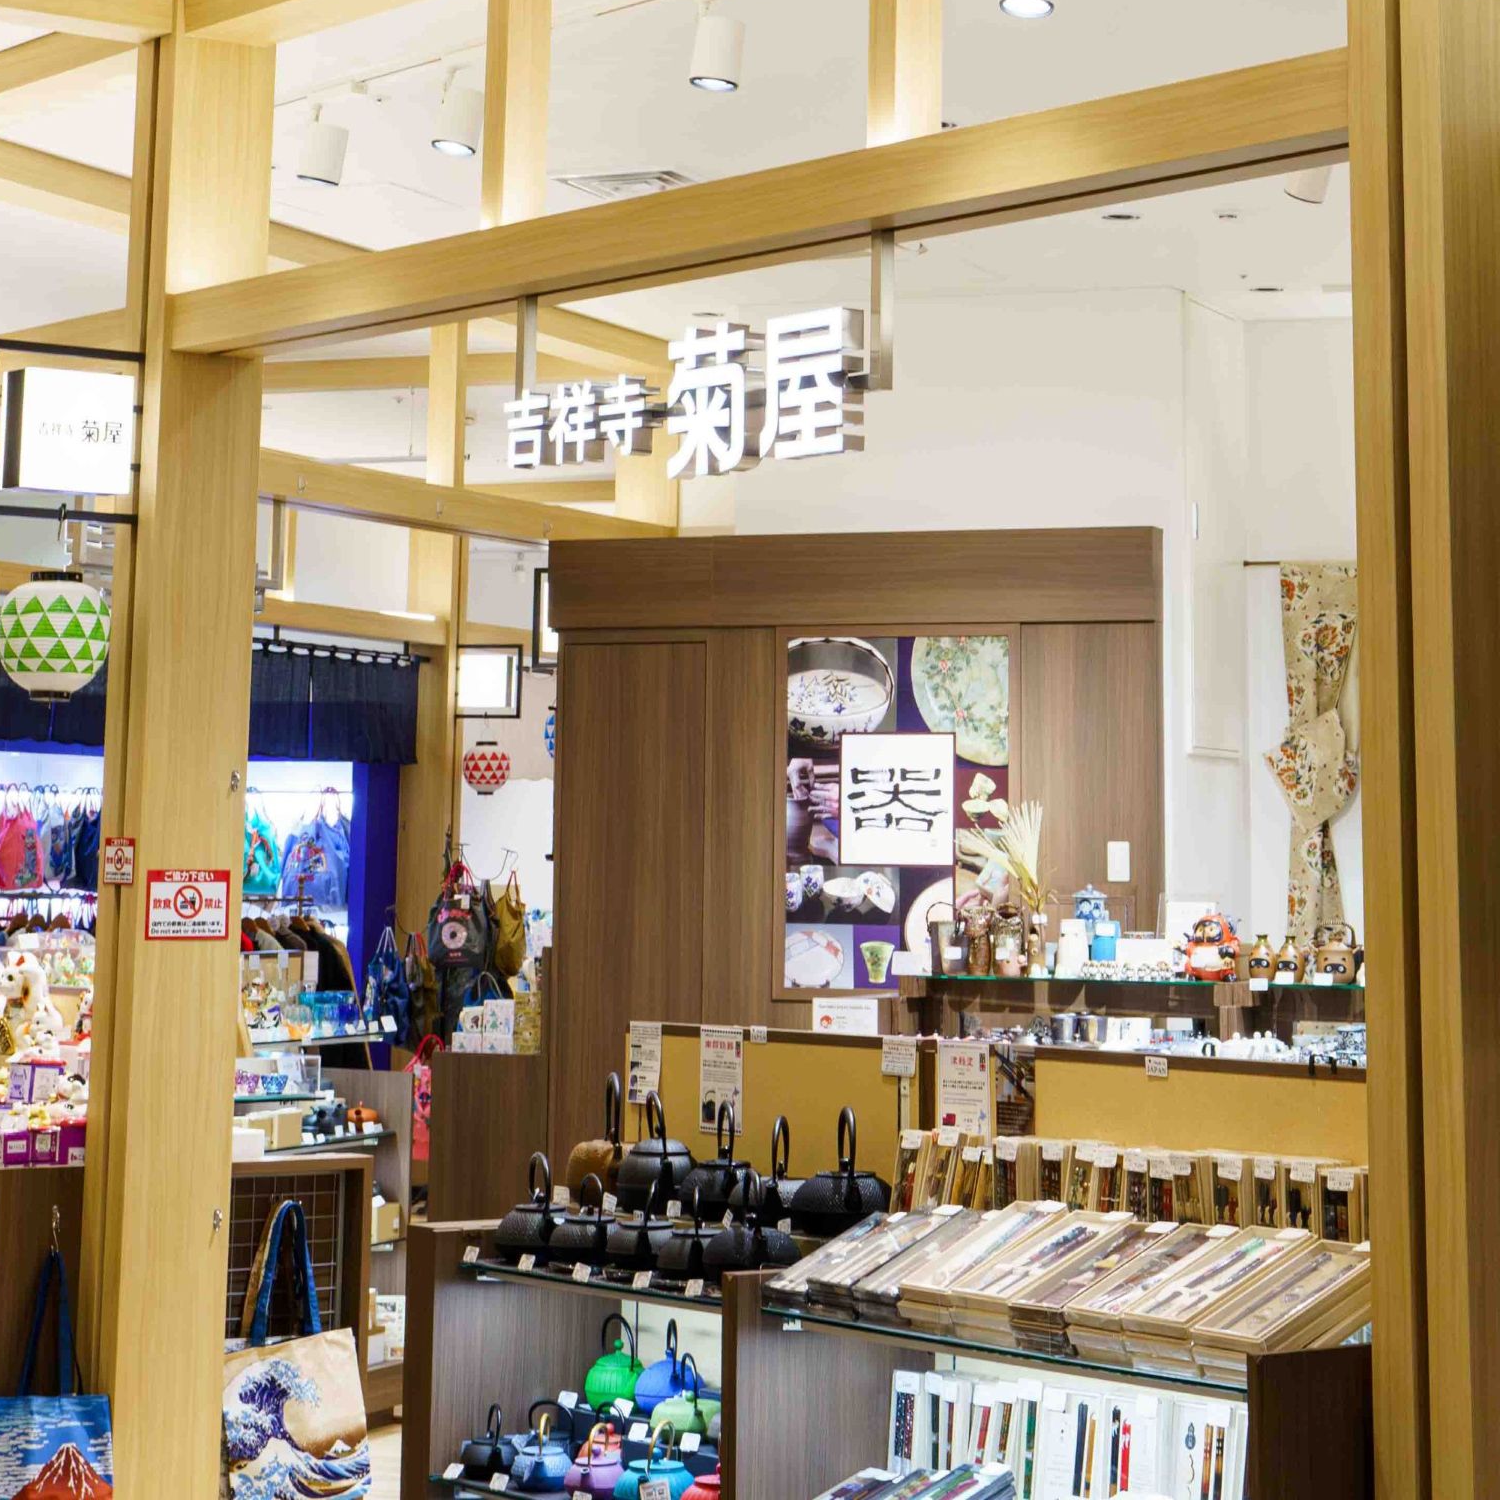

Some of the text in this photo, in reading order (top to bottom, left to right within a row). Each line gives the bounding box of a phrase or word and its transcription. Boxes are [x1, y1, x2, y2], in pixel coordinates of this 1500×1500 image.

[503, 305, 846, 480] 吉祥寺 菊屋
[81, 419, 123, 444] 菊屋
[164, 871, 215, 882] ご協力下さい
[153, 897, 223, 909] 飲食 禁止
